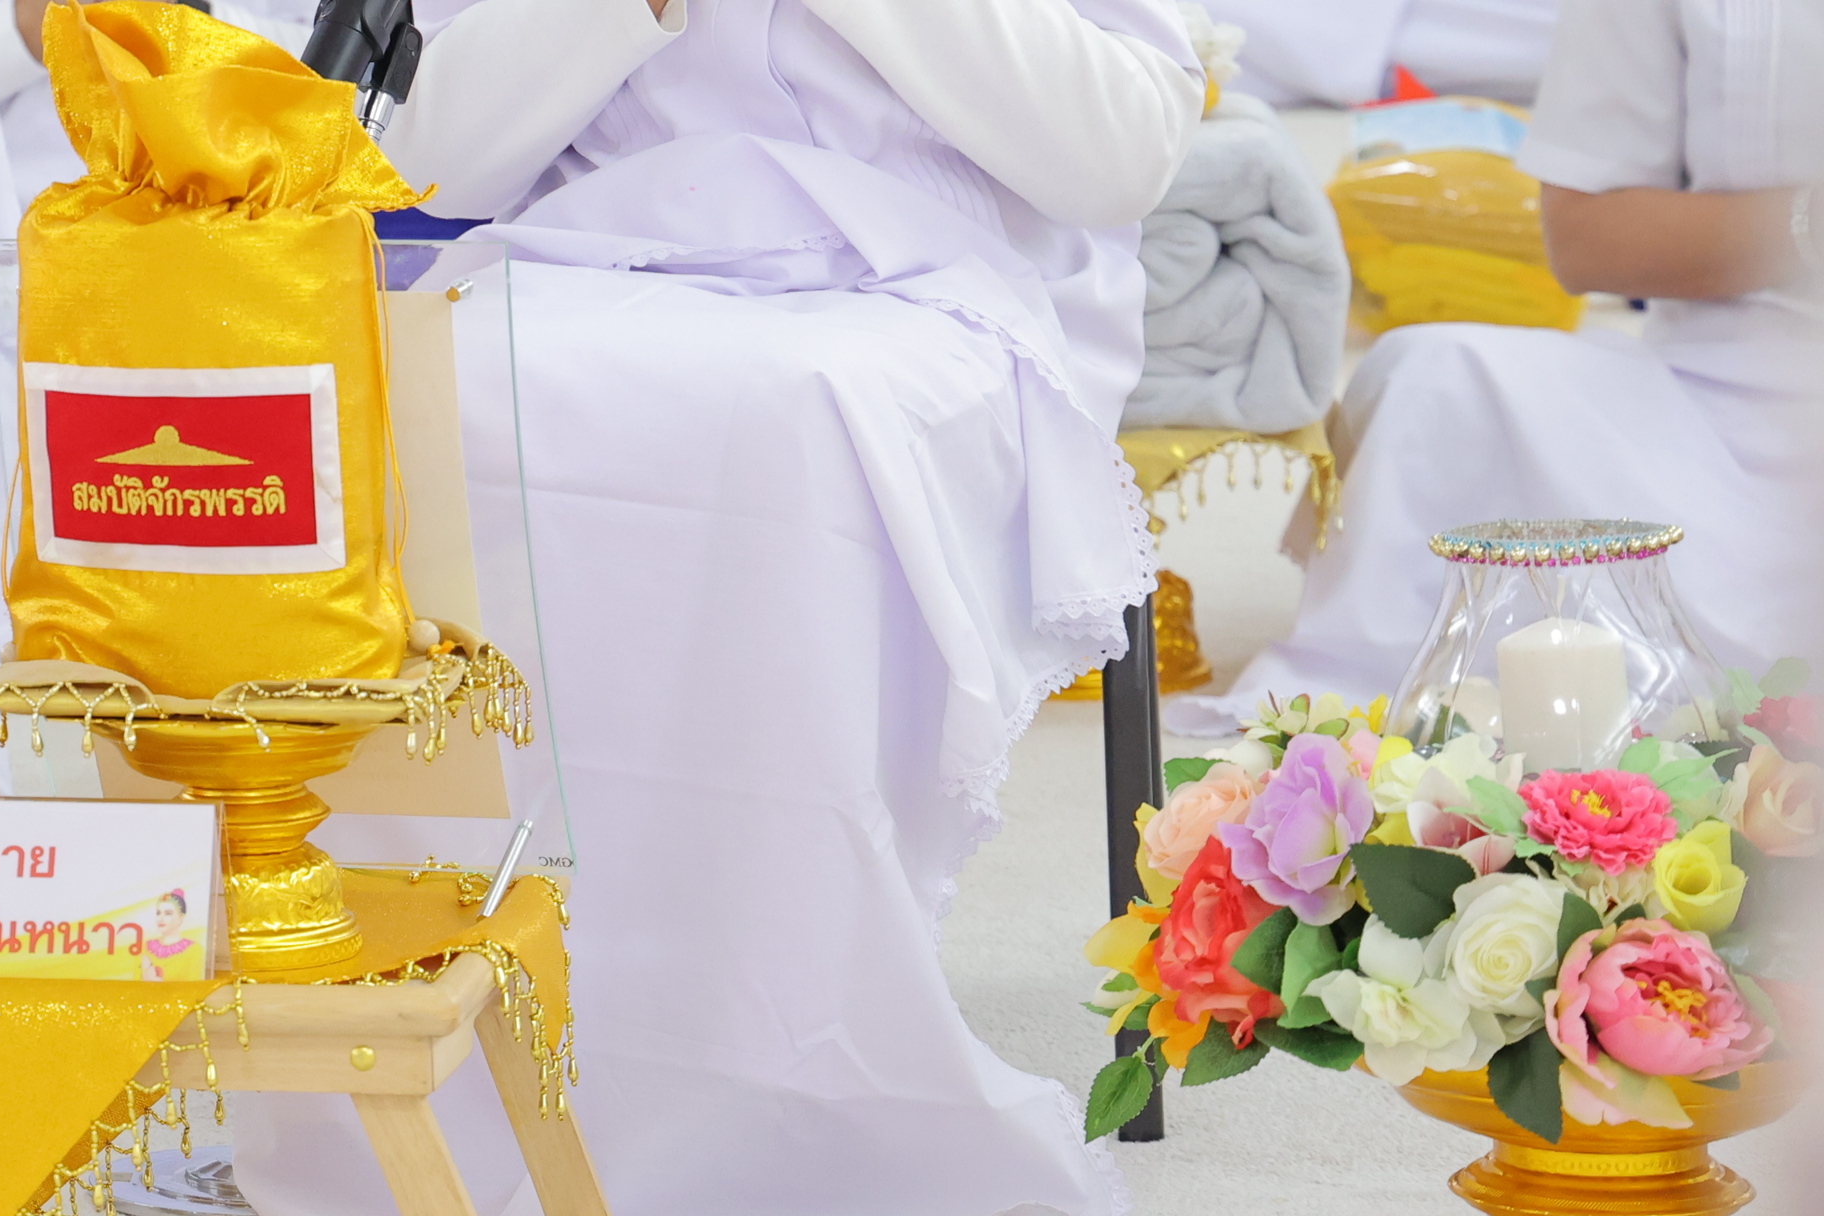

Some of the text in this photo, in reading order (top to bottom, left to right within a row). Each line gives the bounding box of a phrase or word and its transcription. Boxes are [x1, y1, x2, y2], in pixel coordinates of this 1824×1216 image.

[72, 473, 287, 518] สมบัติจักรพรรดิ
